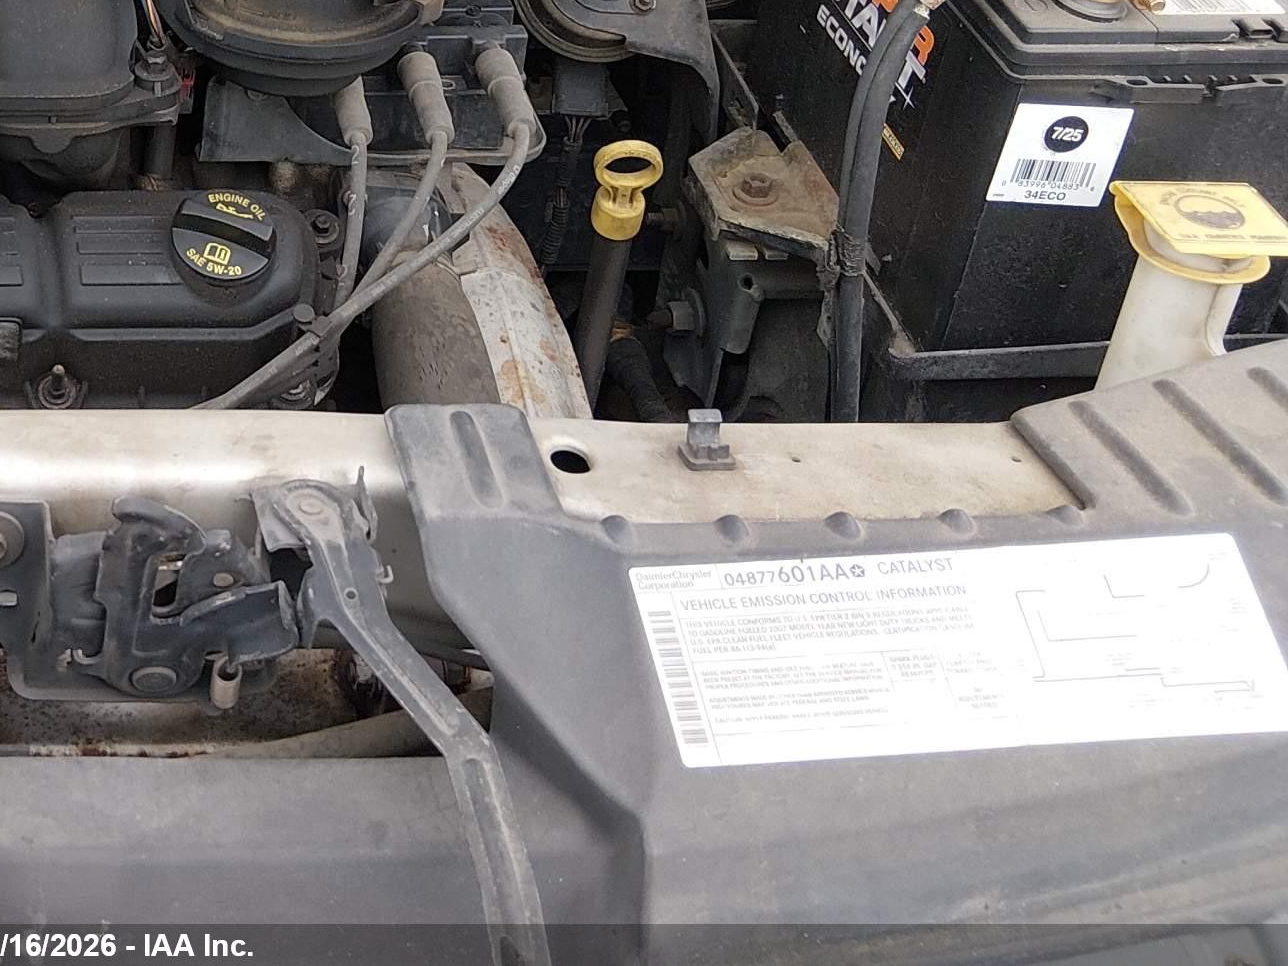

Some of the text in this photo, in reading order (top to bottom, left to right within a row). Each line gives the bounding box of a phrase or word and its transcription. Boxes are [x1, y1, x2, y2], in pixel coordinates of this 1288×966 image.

[1051, 126, 1084, 142] 7/25
[1024, 190, 1066, 201] 34ECO
[207, 192, 266, 221] ENGINE OIL
[186, 247, 242, 276] SAE 5W-20
[635, 569, 713, 582] DaimlerChrysler
[724, 557, 954, 587] 04877601AA CATALYST
[637, 578, 695, 592] Corporation
[680, 585, 967, 611] VEHICLE EMISSION CONTROL INFORMATION
